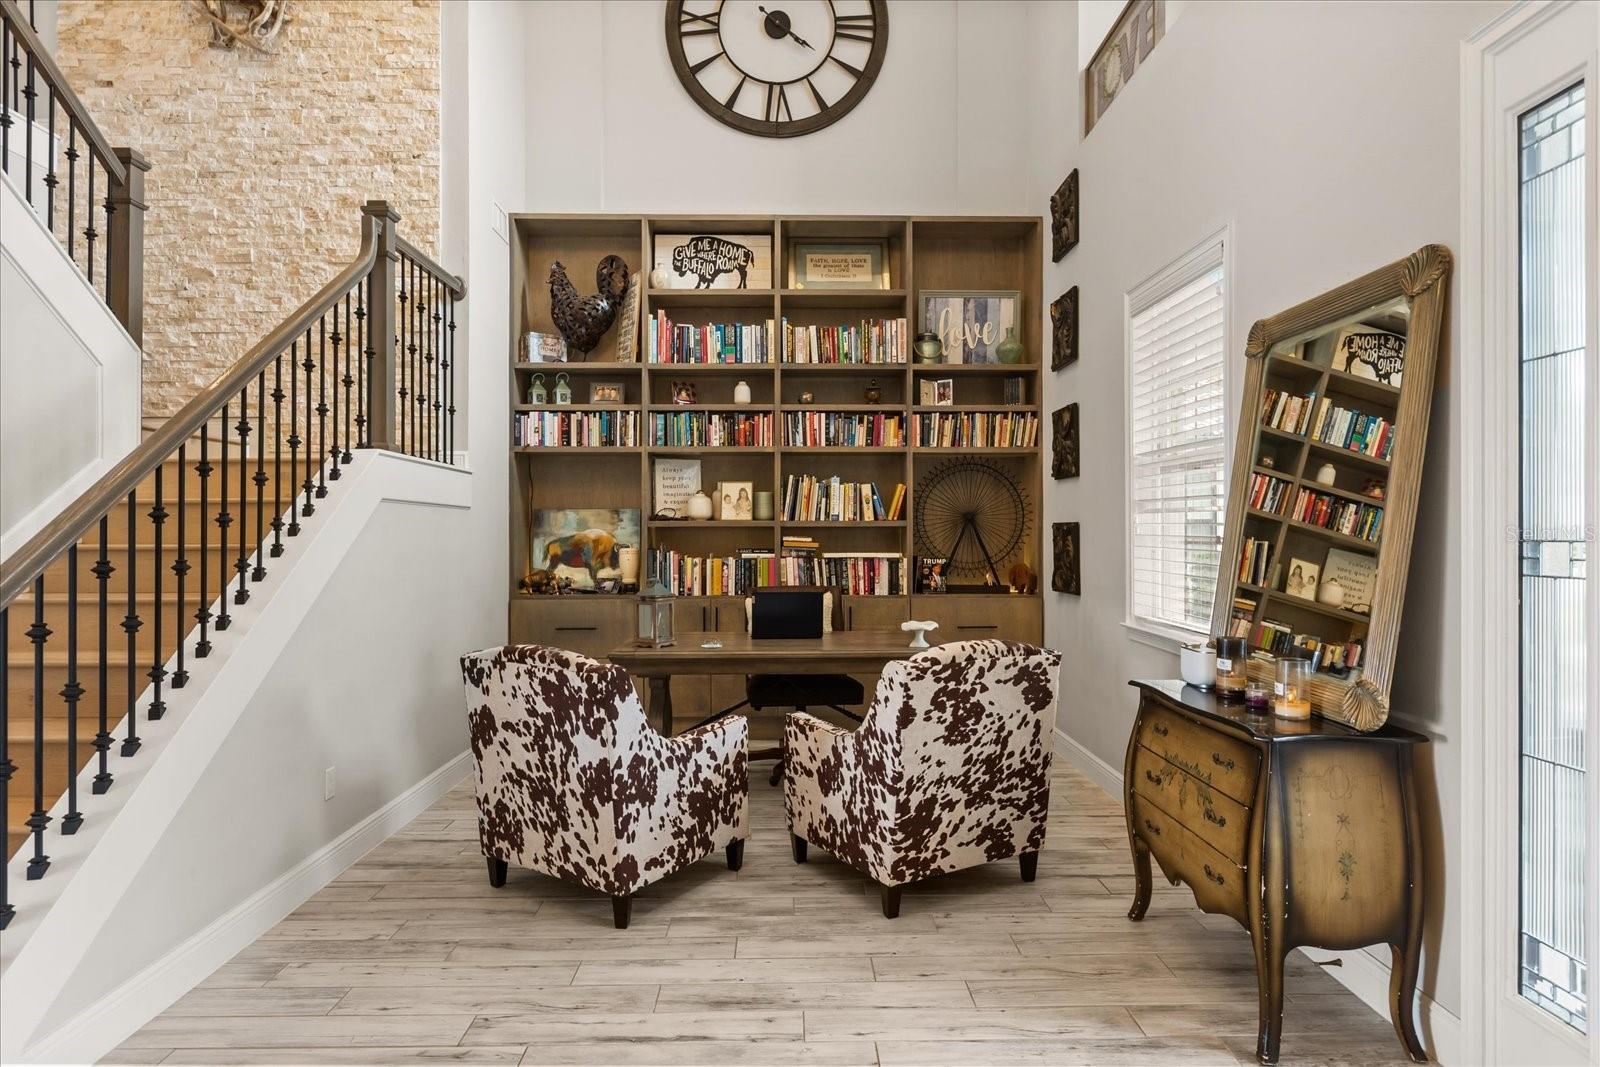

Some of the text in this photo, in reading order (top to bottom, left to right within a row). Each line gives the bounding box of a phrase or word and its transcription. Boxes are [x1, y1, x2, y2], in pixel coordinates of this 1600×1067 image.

[697, 250, 717, 261] WHERE
[698, 238, 712, 251] ME
[712, 240, 718, 250] A
[719, 241, 748, 265] HOME
[682, 258, 715, 279] BUFFALO
[716, 254, 739, 271] ROAM
[938, 307, 998, 356] love
